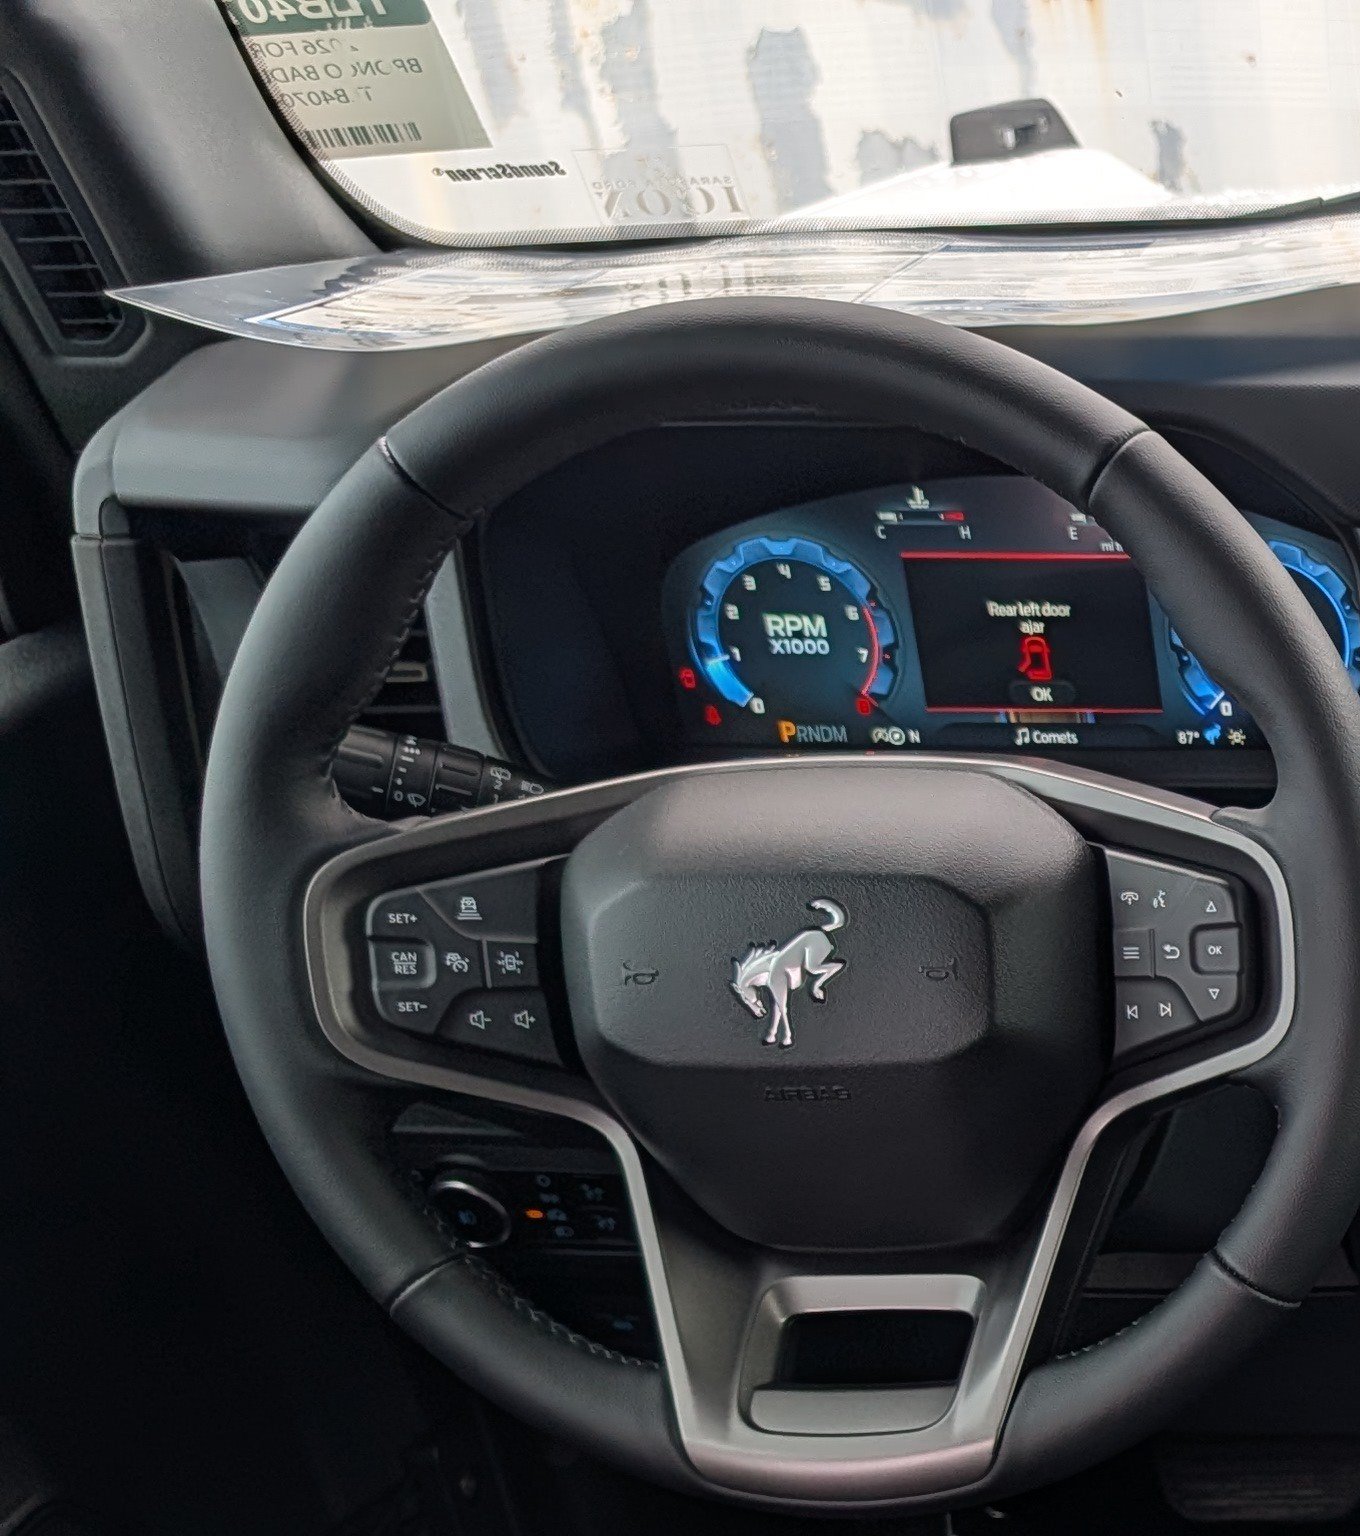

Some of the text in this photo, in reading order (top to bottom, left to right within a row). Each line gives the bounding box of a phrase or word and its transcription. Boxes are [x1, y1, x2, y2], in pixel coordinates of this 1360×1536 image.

[875, 526, 886, 539] C
[959, 526, 971, 540] H
[1068, 526, 1078, 540] E
[777, 564, 791, 579] 4
[743, 576, 756, 591] 3
[818, 577, 832, 591] 5
[724, 605, 740, 620] 2
[845, 606, 859, 621] 6
[986, 601, 1070, 617] Rear left door
[762, 614, 827, 638] RPM
[1019, 621, 1045, 635] ajar
[729, 646, 741, 662] 1
[770, 639, 829, 655] X1000
[857, 648, 868, 663] 7
[1030, 687, 1053, 701] OK
[750, 698, 765, 713] 0
[1033, 730, 1078, 744] Comets
[1177, 730, 1199, 744] 87°
[387, 912, 418, 924] SET+
[392, 951, 418, 962] CAN
[1207, 945, 1223, 955] OK
[394, 963, 417, 975] RES
